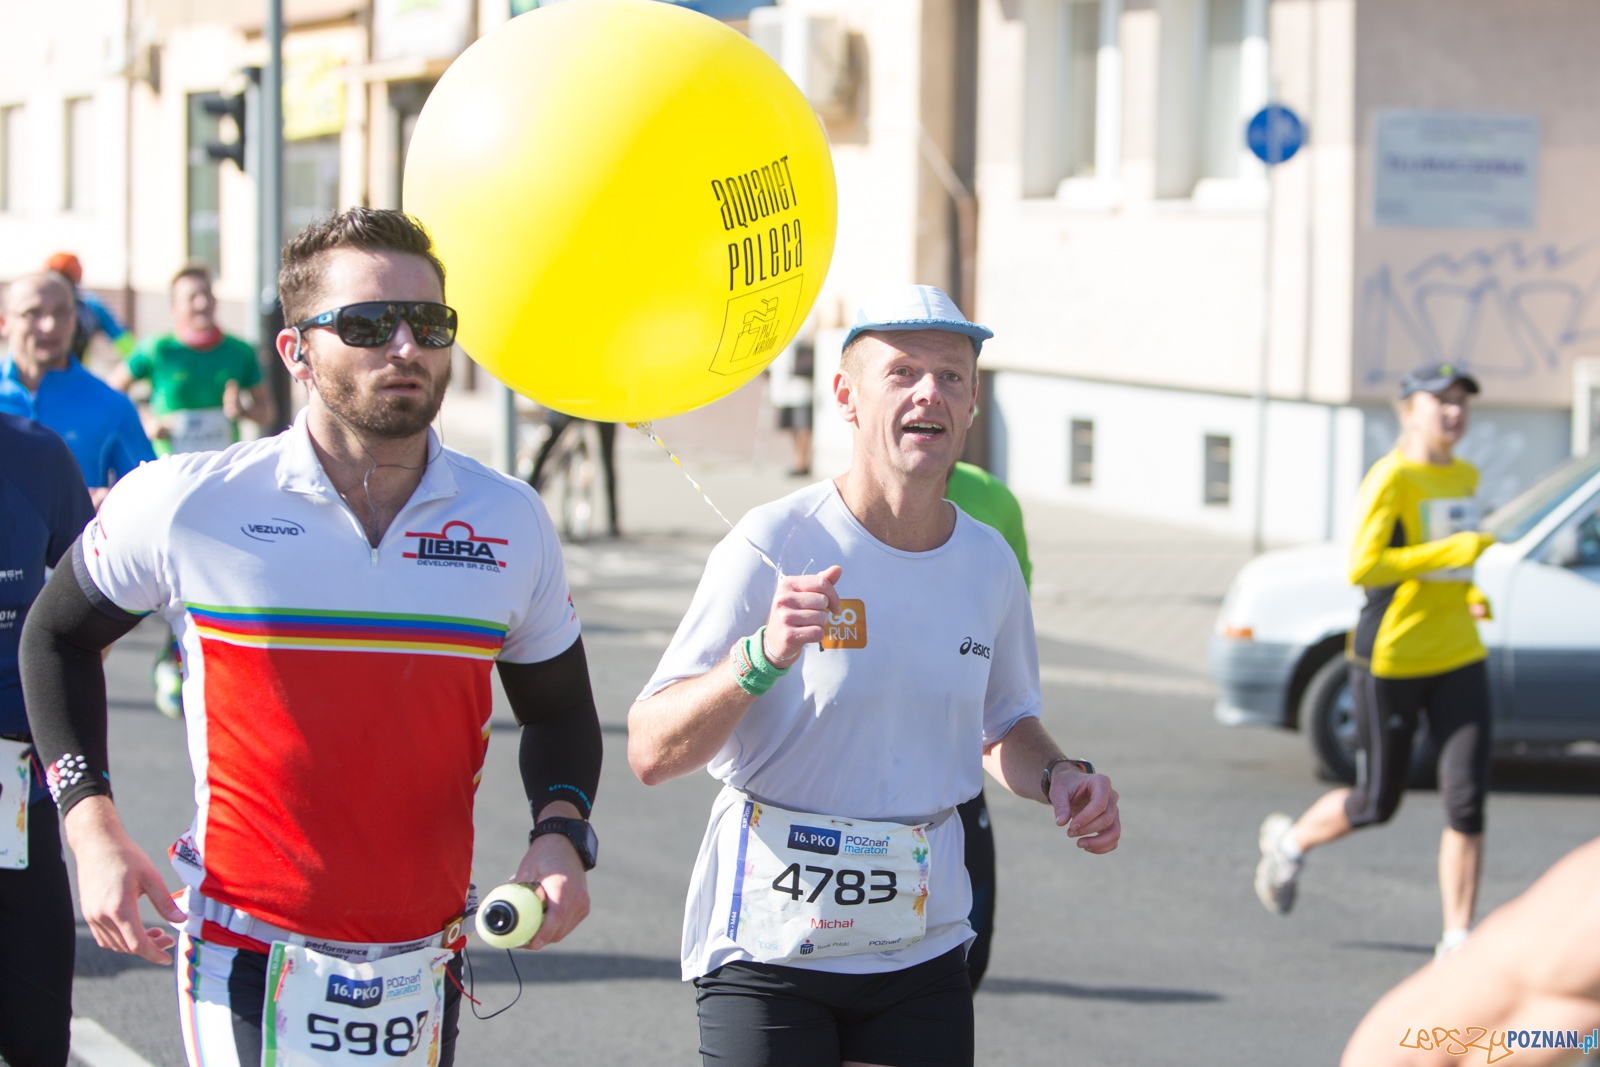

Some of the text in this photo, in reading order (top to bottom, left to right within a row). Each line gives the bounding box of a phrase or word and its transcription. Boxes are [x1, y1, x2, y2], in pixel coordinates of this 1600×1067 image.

[247, 523, 300, 536] VEZUVIO
[418, 537, 499, 567] LIBRA
[416, 559, 465, 569] DEVELOPER
[828, 626, 858, 641] RUN
[971, 641, 992, 660] asics
[844, 844, 888, 855] maraton
[772, 862, 898, 906] 4783
[810, 917, 855, 930] Michał
[305, 941, 368, 956] performance
[386, 983, 421, 998] maraton
